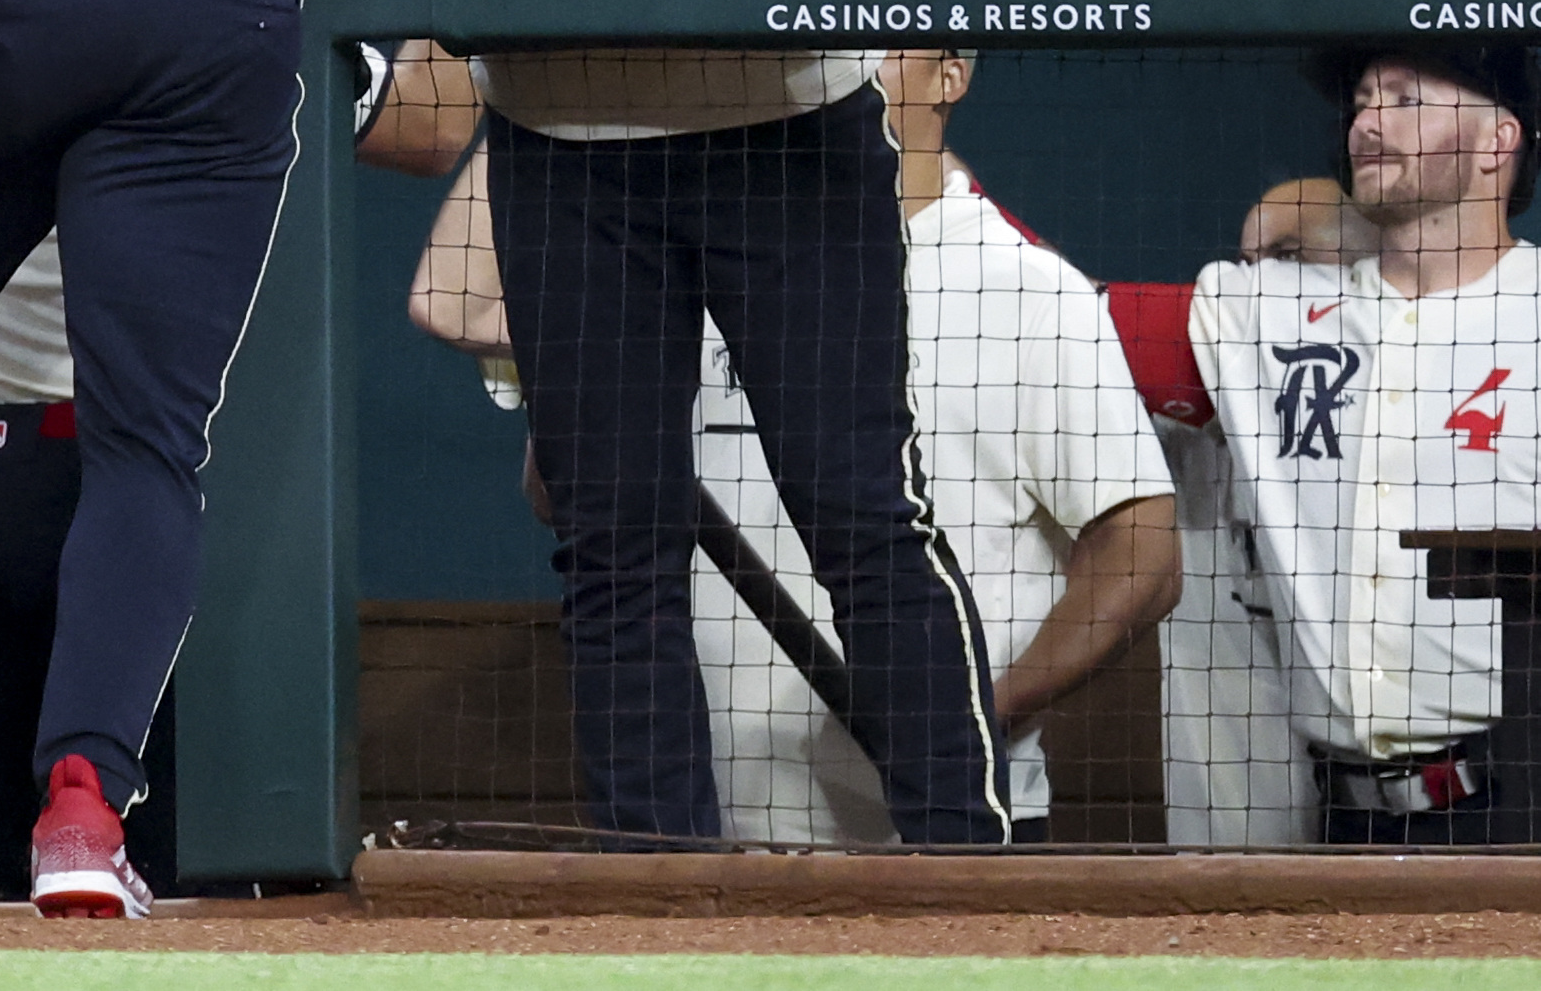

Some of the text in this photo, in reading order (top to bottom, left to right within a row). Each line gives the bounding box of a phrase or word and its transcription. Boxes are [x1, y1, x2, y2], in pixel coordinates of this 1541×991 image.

[766, 2, 1152, 33] CASINOS & RESORTS
[1443, 368, 1512, 454] 4
